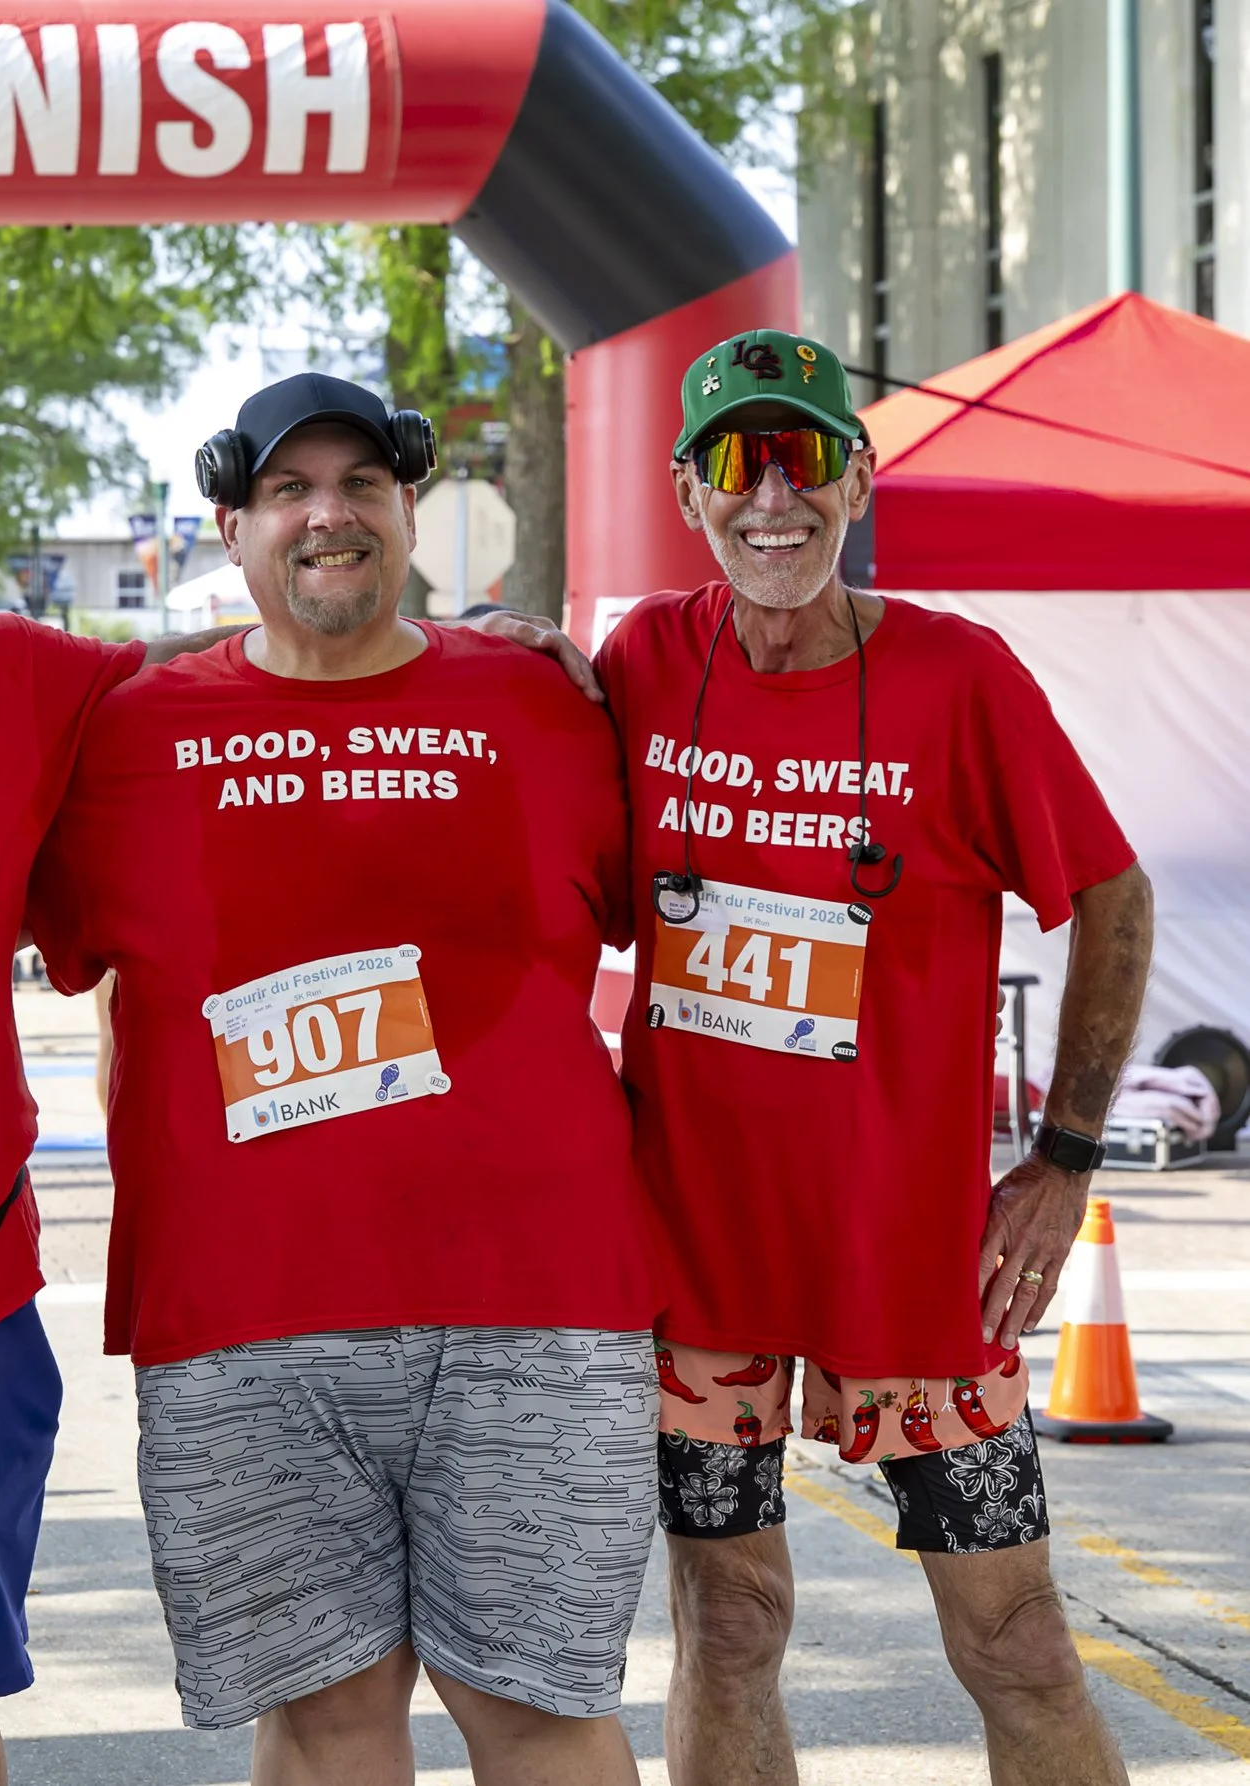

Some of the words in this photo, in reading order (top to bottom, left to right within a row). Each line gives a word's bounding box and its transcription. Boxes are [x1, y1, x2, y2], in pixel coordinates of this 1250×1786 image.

[175, 729, 330, 770] BLOOD,
[347, 727, 497, 765] SWEAT,
[645, 733, 763, 797] BLOOD,
[774, 758, 914, 805] SWEAT,
[217, 773, 305, 810] AND
[321, 769, 458, 801] BEERS
[658, 796, 733, 838] AND
[744, 809, 872, 849] BEERS
[725, 894, 743, 908] du
[748, 897, 805, 919] Festival
[809, 908, 845, 925] 2026
[755, 918, 770, 927] Run
[225, 987, 267, 1012] Courir
[271, 980, 290, 999] du
[293, 962, 352, 988] Festival
[356, 956, 394, 972] 2026
[686, 931, 812, 1009] 441
[247, 989, 383, 1087] 907
